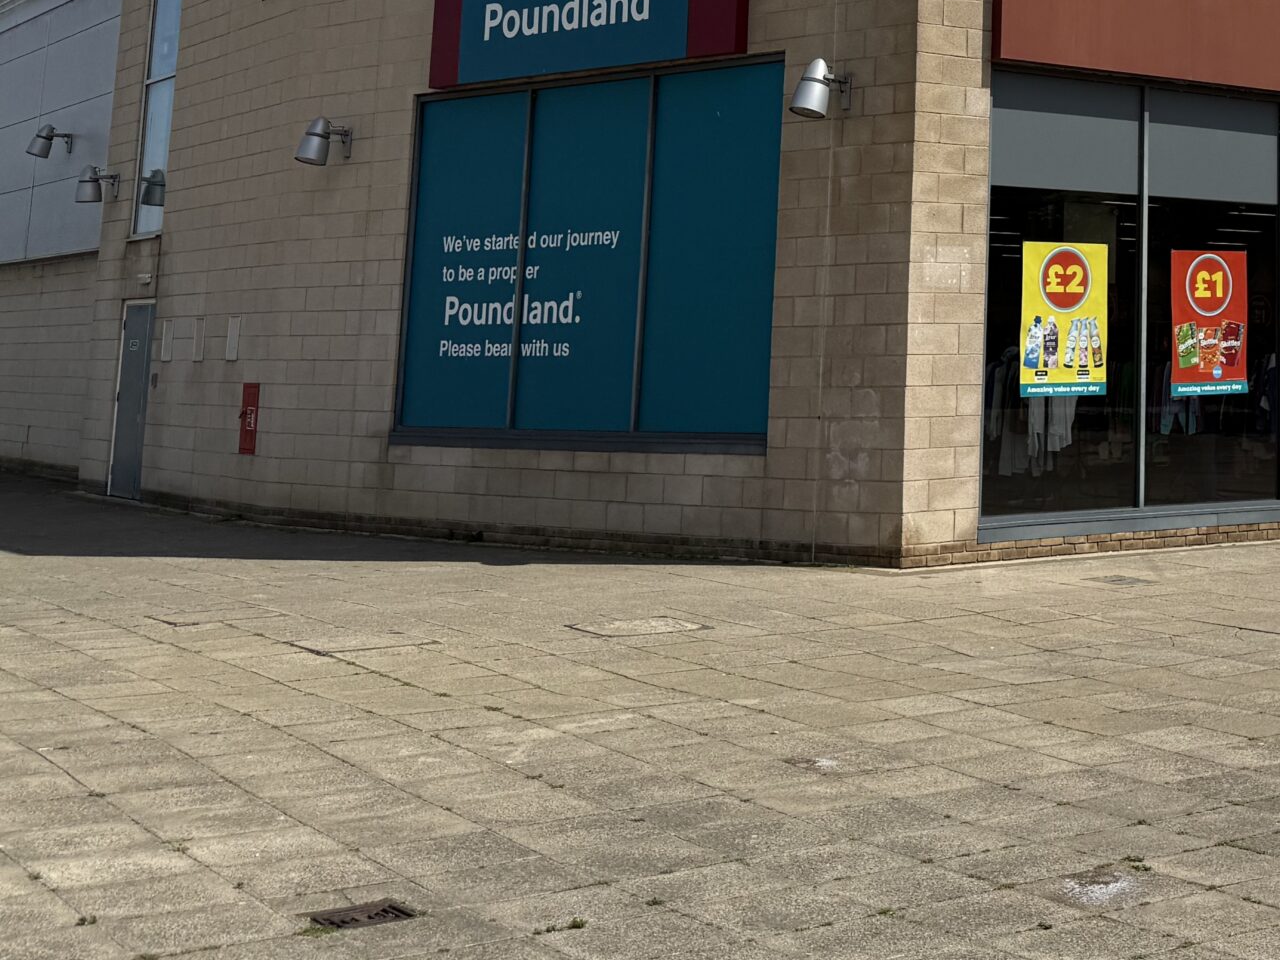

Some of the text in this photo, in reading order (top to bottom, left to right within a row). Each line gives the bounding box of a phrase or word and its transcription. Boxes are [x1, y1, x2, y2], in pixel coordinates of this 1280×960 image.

[443, 235, 481, 252] We've
[540, 233, 563, 248] our
[565, 229, 620, 252] journey
[442, 266, 455, 282] to
[458, 265, 474, 281] be
[477, 267, 485, 280] a
[1046, 264, 1085, 293] £2
[1194, 270, 1223, 298] £1
[439, 340, 482, 357] Please
[521, 339, 549, 357] with
[553, 341, 570, 357] us
[1027, 385, 1053, 394] Amazing
[1071, 385, 1087, 393] every
[1088, 384, 1100, 392] day
